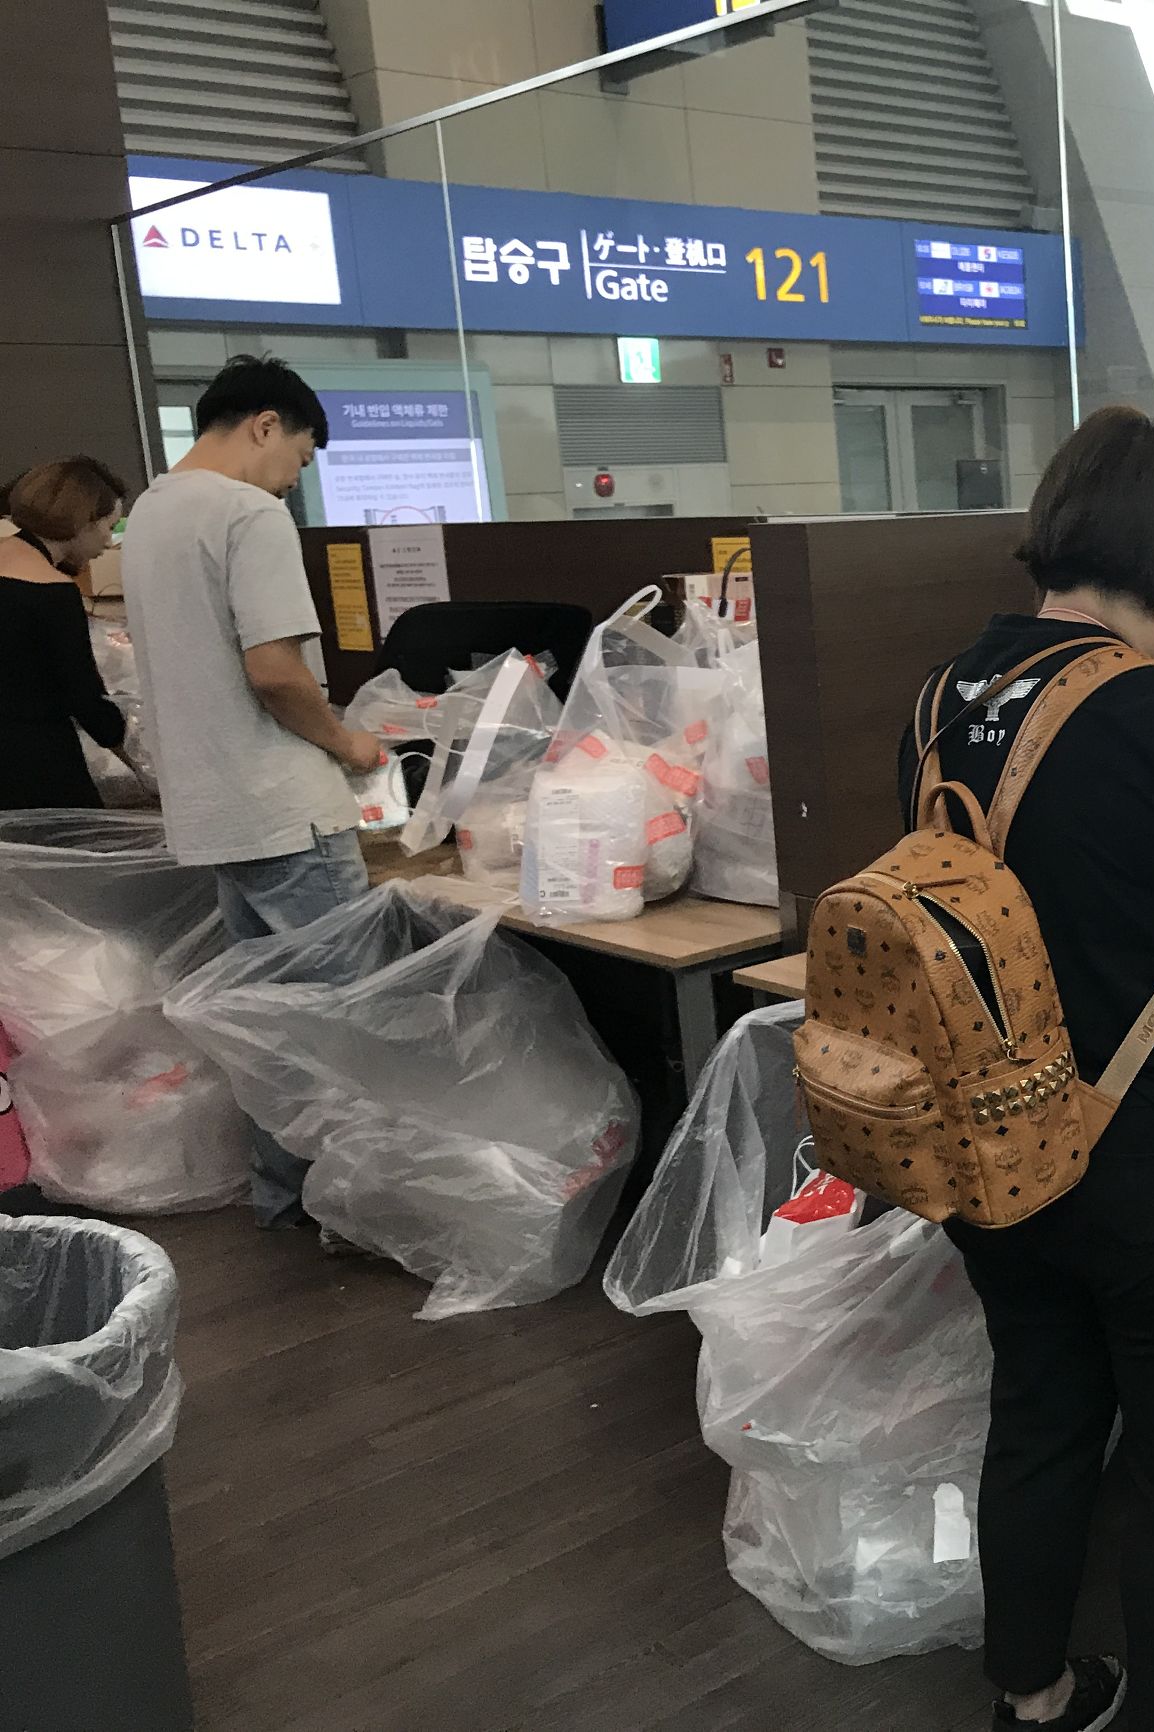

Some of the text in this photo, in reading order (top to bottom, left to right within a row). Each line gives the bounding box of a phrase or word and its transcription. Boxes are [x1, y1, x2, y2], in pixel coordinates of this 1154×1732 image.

[181, 227, 292, 253] DELTA
[462, 235, 570, 285] 탑승구
[745, 247, 829, 303] 121
[595, 269, 669, 302] Gate
[967, 724, 1006, 746] Boy
